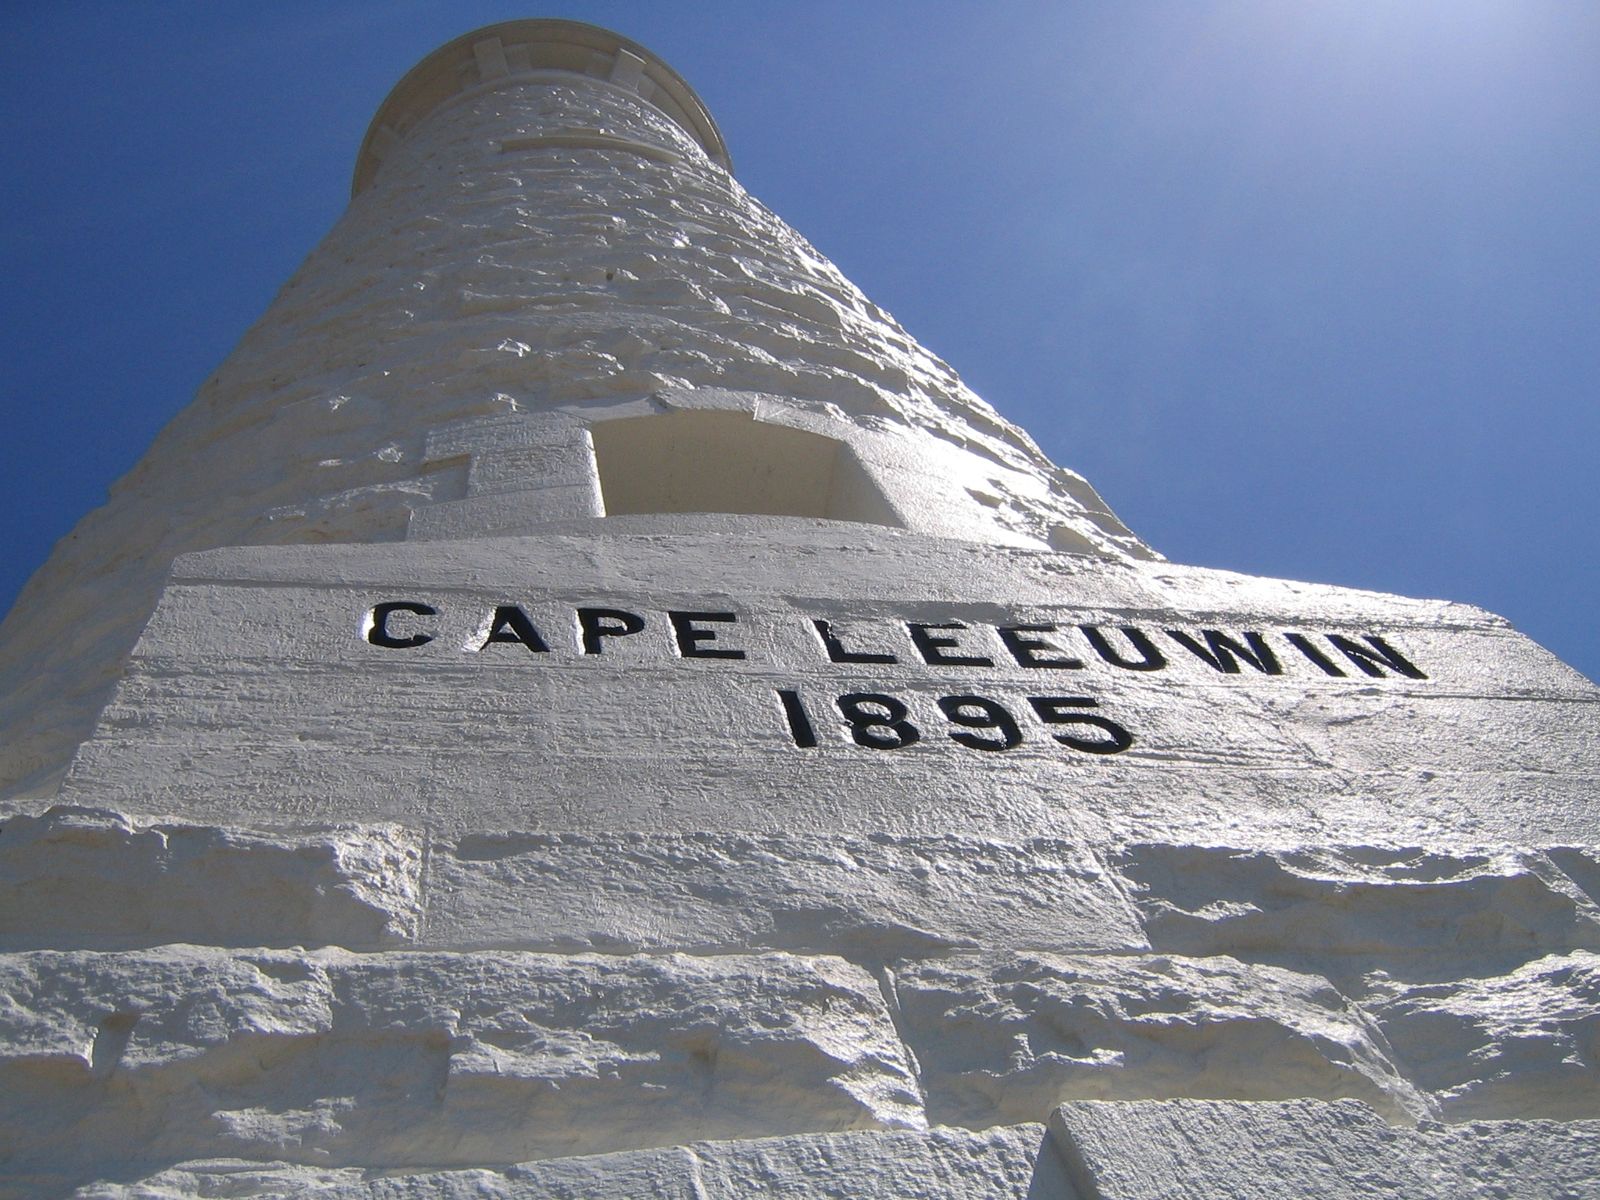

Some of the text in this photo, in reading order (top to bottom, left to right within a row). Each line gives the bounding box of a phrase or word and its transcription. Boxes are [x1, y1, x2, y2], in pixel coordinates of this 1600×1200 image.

[363, 602, 1428, 680] CAPE LEEUWIN
[777, 690, 1132, 754] 1895
